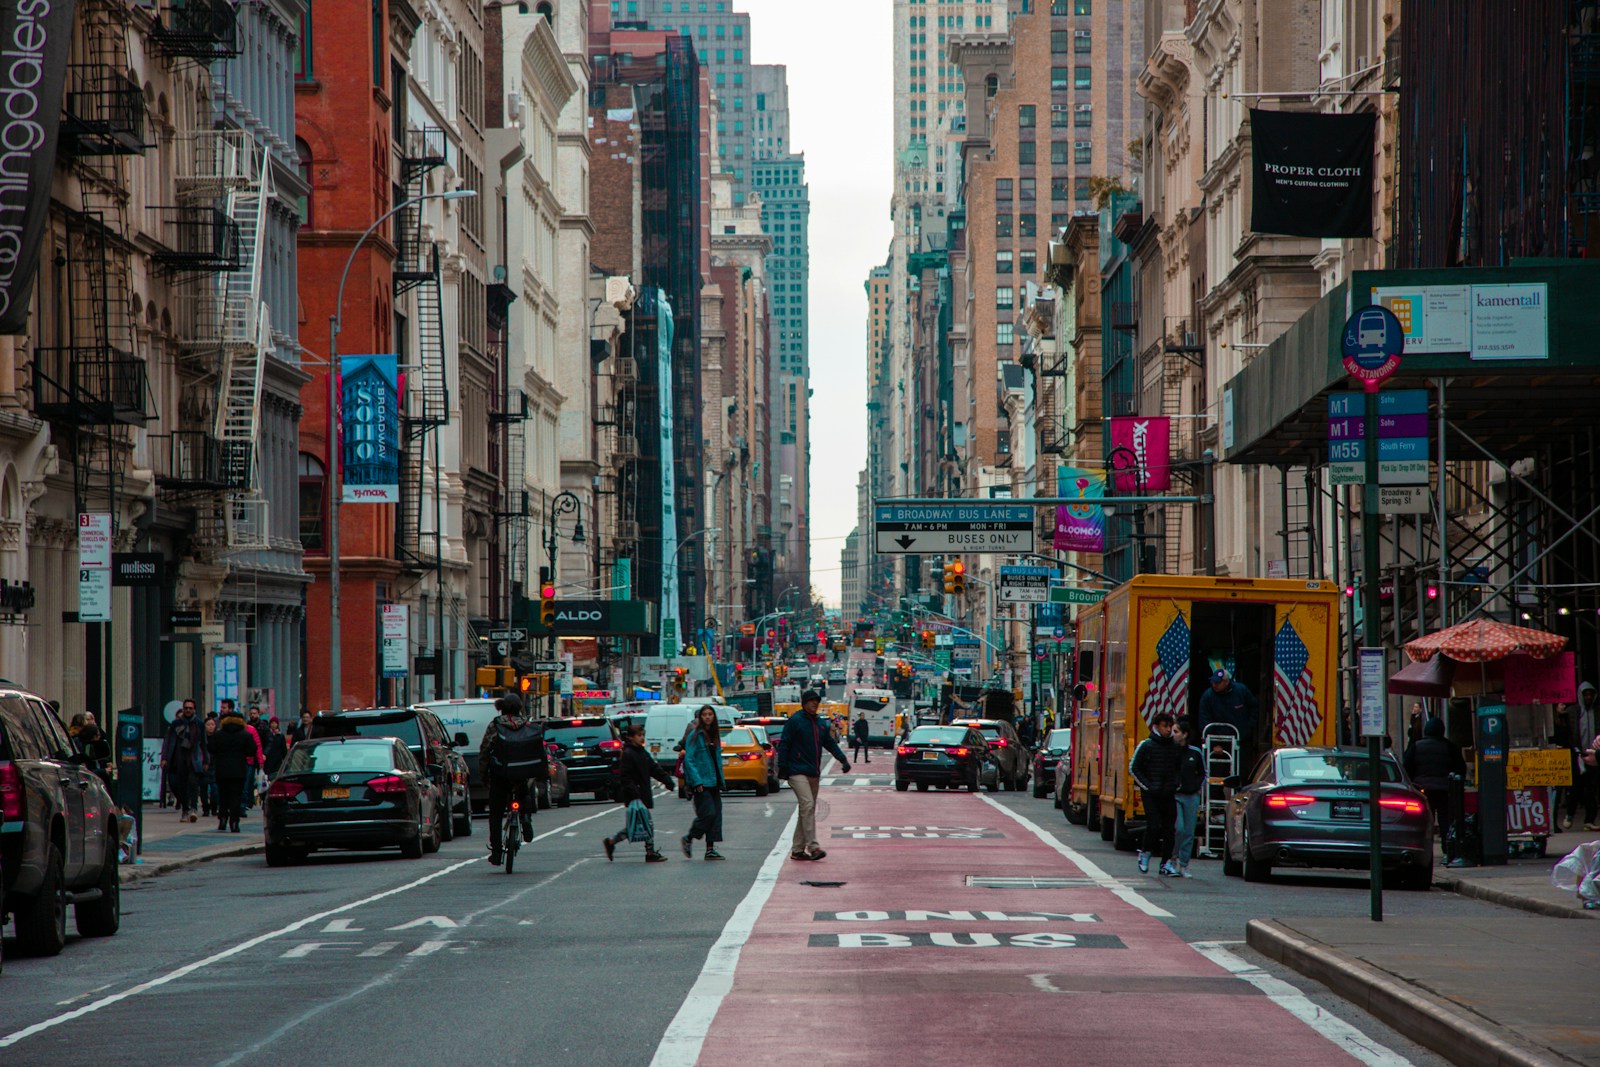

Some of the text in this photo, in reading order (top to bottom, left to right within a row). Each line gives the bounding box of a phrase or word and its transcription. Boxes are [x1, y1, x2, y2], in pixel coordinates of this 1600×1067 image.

[1264, 162, 1361, 177] PROPER CLOTH
[1275, 178, 1293, 186] MEN'S
[1347, 360, 1397, 379] NO STANDING
[1380, 396, 1395, 404] Soho
[1331, 397, 1349, 414] M1
[377, 387, 386, 459] BROADWAY
[1380, 418, 1395, 427] Soho
[1331, 420, 1349, 437] M1
[1331, 442, 1359, 459] M55
[1380, 441, 1416, 451] South Ferry
[1331, 465, 1354, 474] Topview
[1331, 474, 1364, 484] Sightseeing
[1381, 488, 1412, 498] Broadway
[1381, 497, 1402, 506] Spring
[897, 510, 1012, 519] BROADWAY BUS LANE
[948, 534, 1019, 544] BUSES ONLY
[120, 560, 156, 574] melissa
[1027, 567, 1046, 575] LANE
[556, 611, 602, 620] ALDO
[442, 718, 475, 727] Culligan
[1488, 718, 1498, 732] P
[127, 725, 136, 738] P
[835, 910, 1098, 922] ONLY
[837, 933, 1077, 948] BUS
